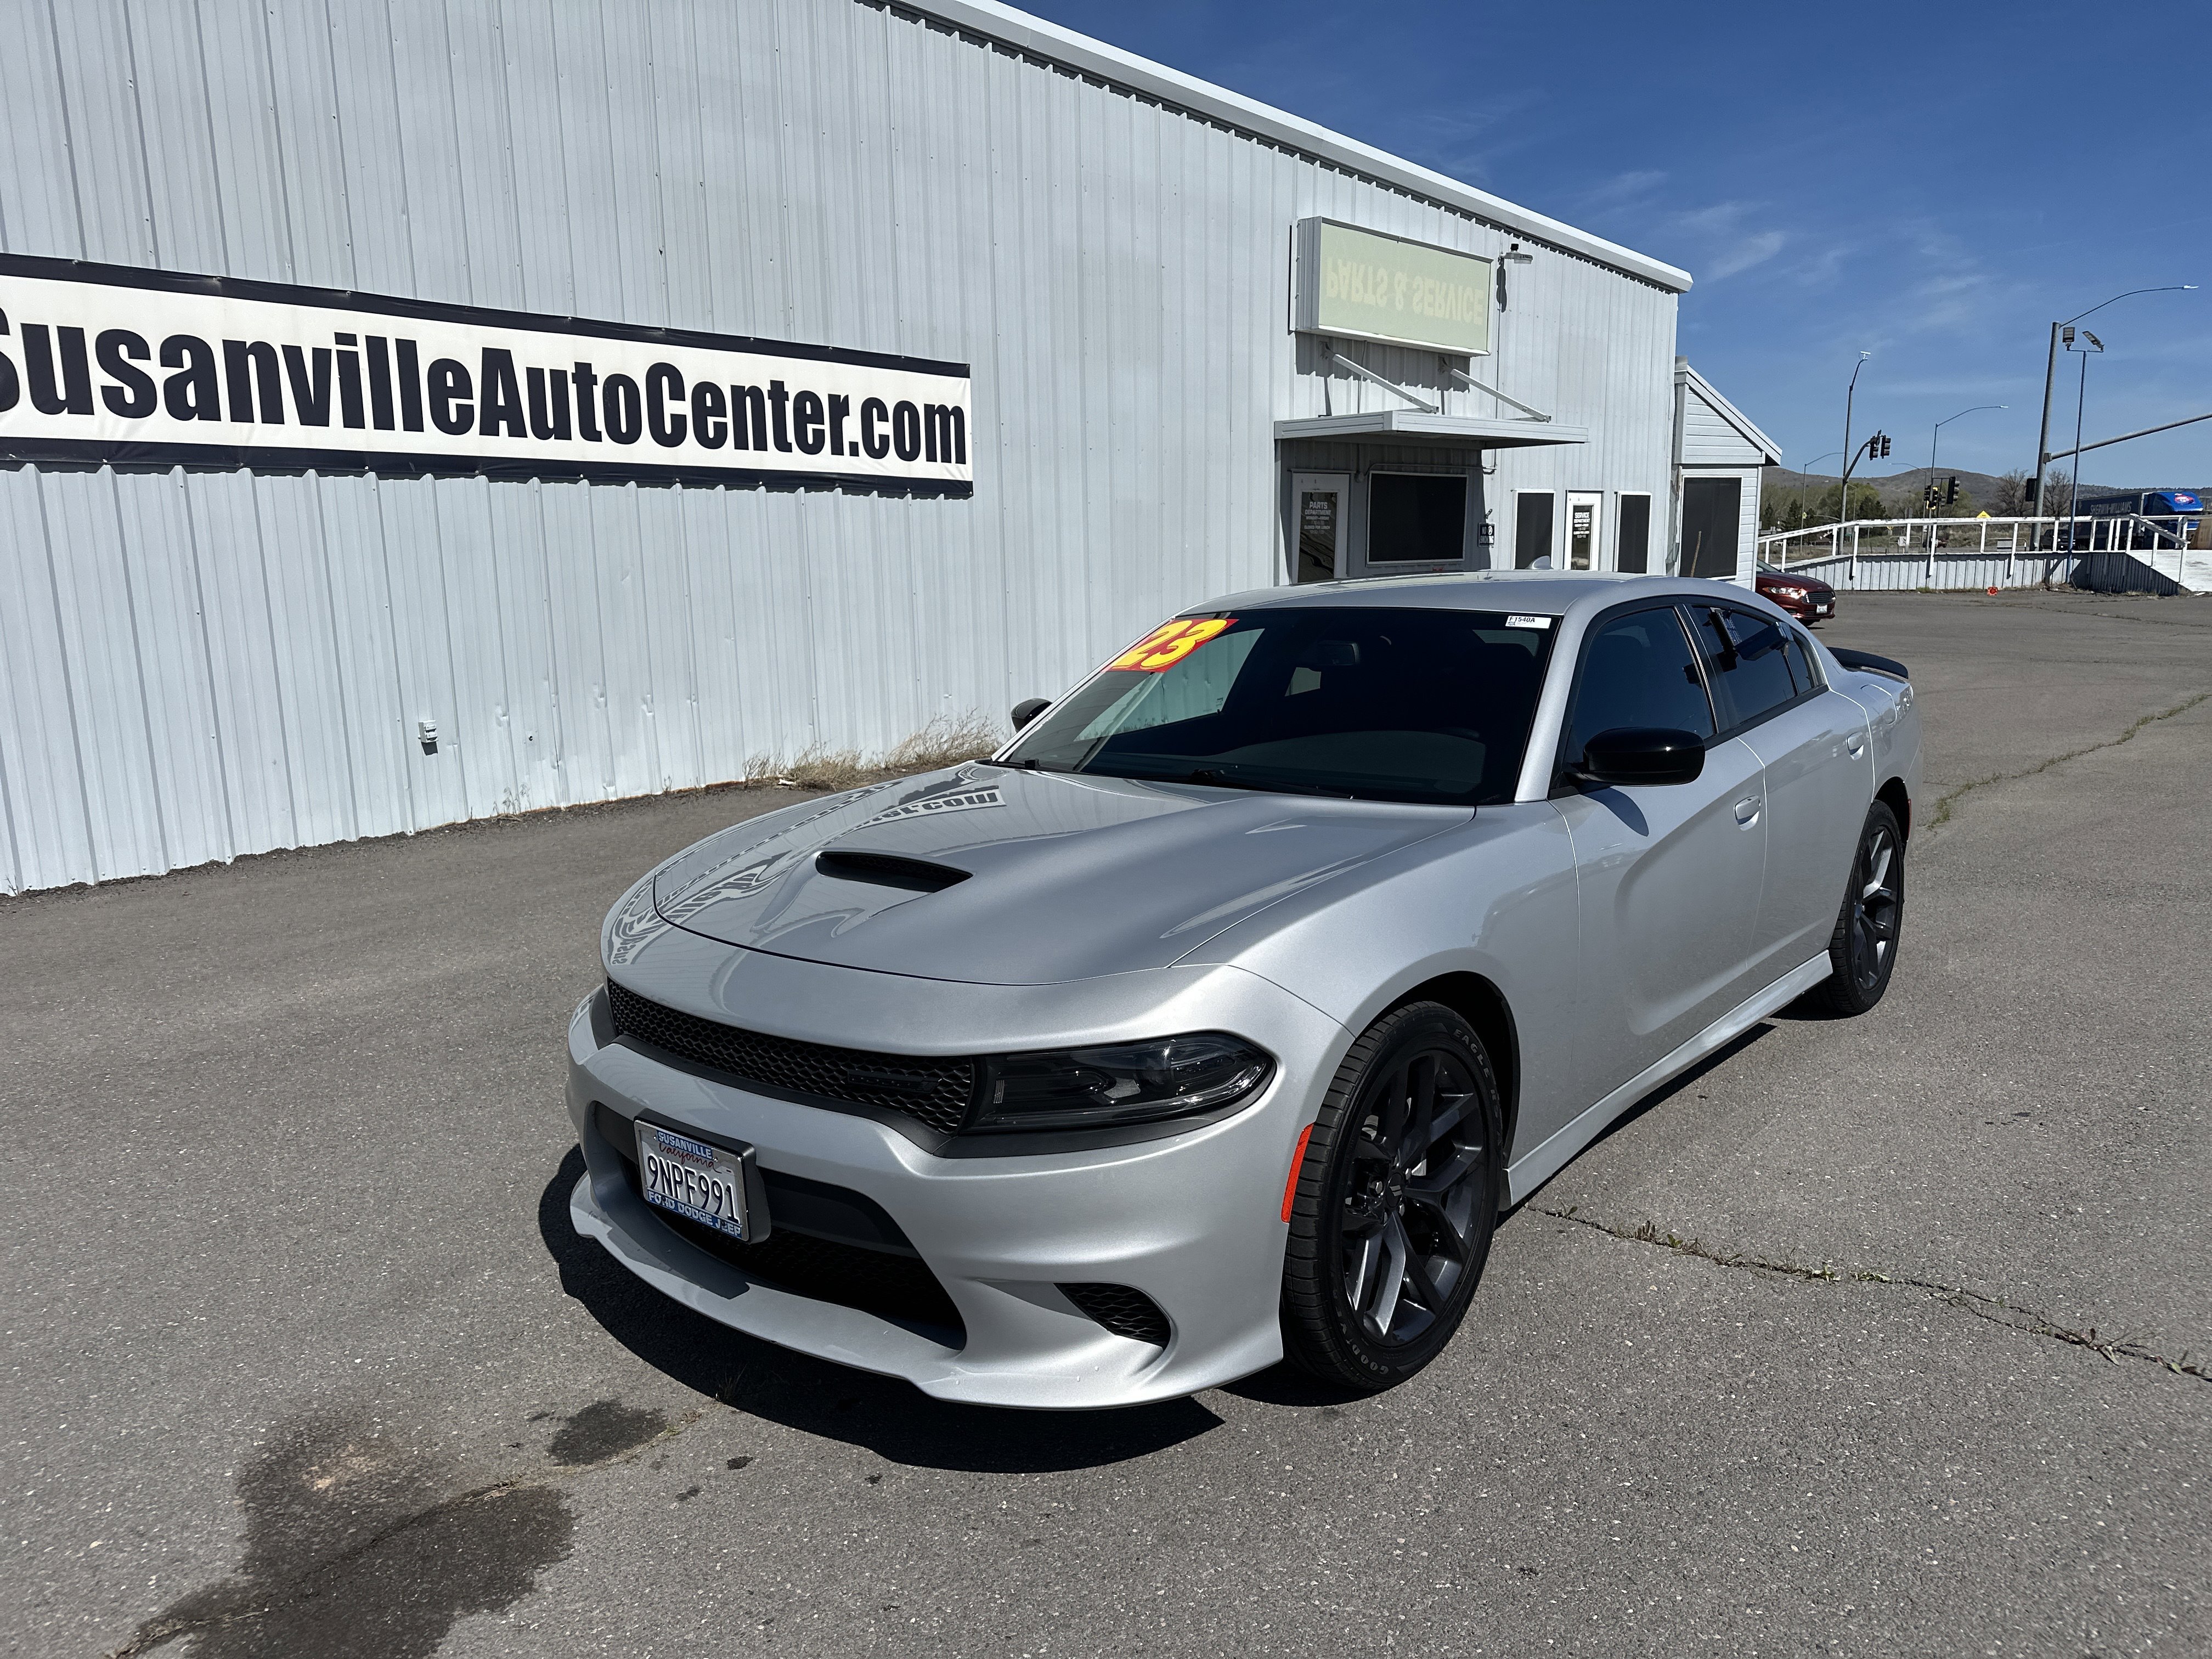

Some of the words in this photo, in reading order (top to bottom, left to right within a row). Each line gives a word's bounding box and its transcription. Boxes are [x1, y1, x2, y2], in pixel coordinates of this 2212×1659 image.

[1309, 501, 1328, 509] PARTS
[1111, 619, 1228, 670] 23
[1454, 1029, 1491, 1078] EAGLE
[658, 1131, 713, 1159] SUSANVILLE
[647, 1154, 741, 1224] 9NPF991
[678, 1202, 713, 1226] DODGE
